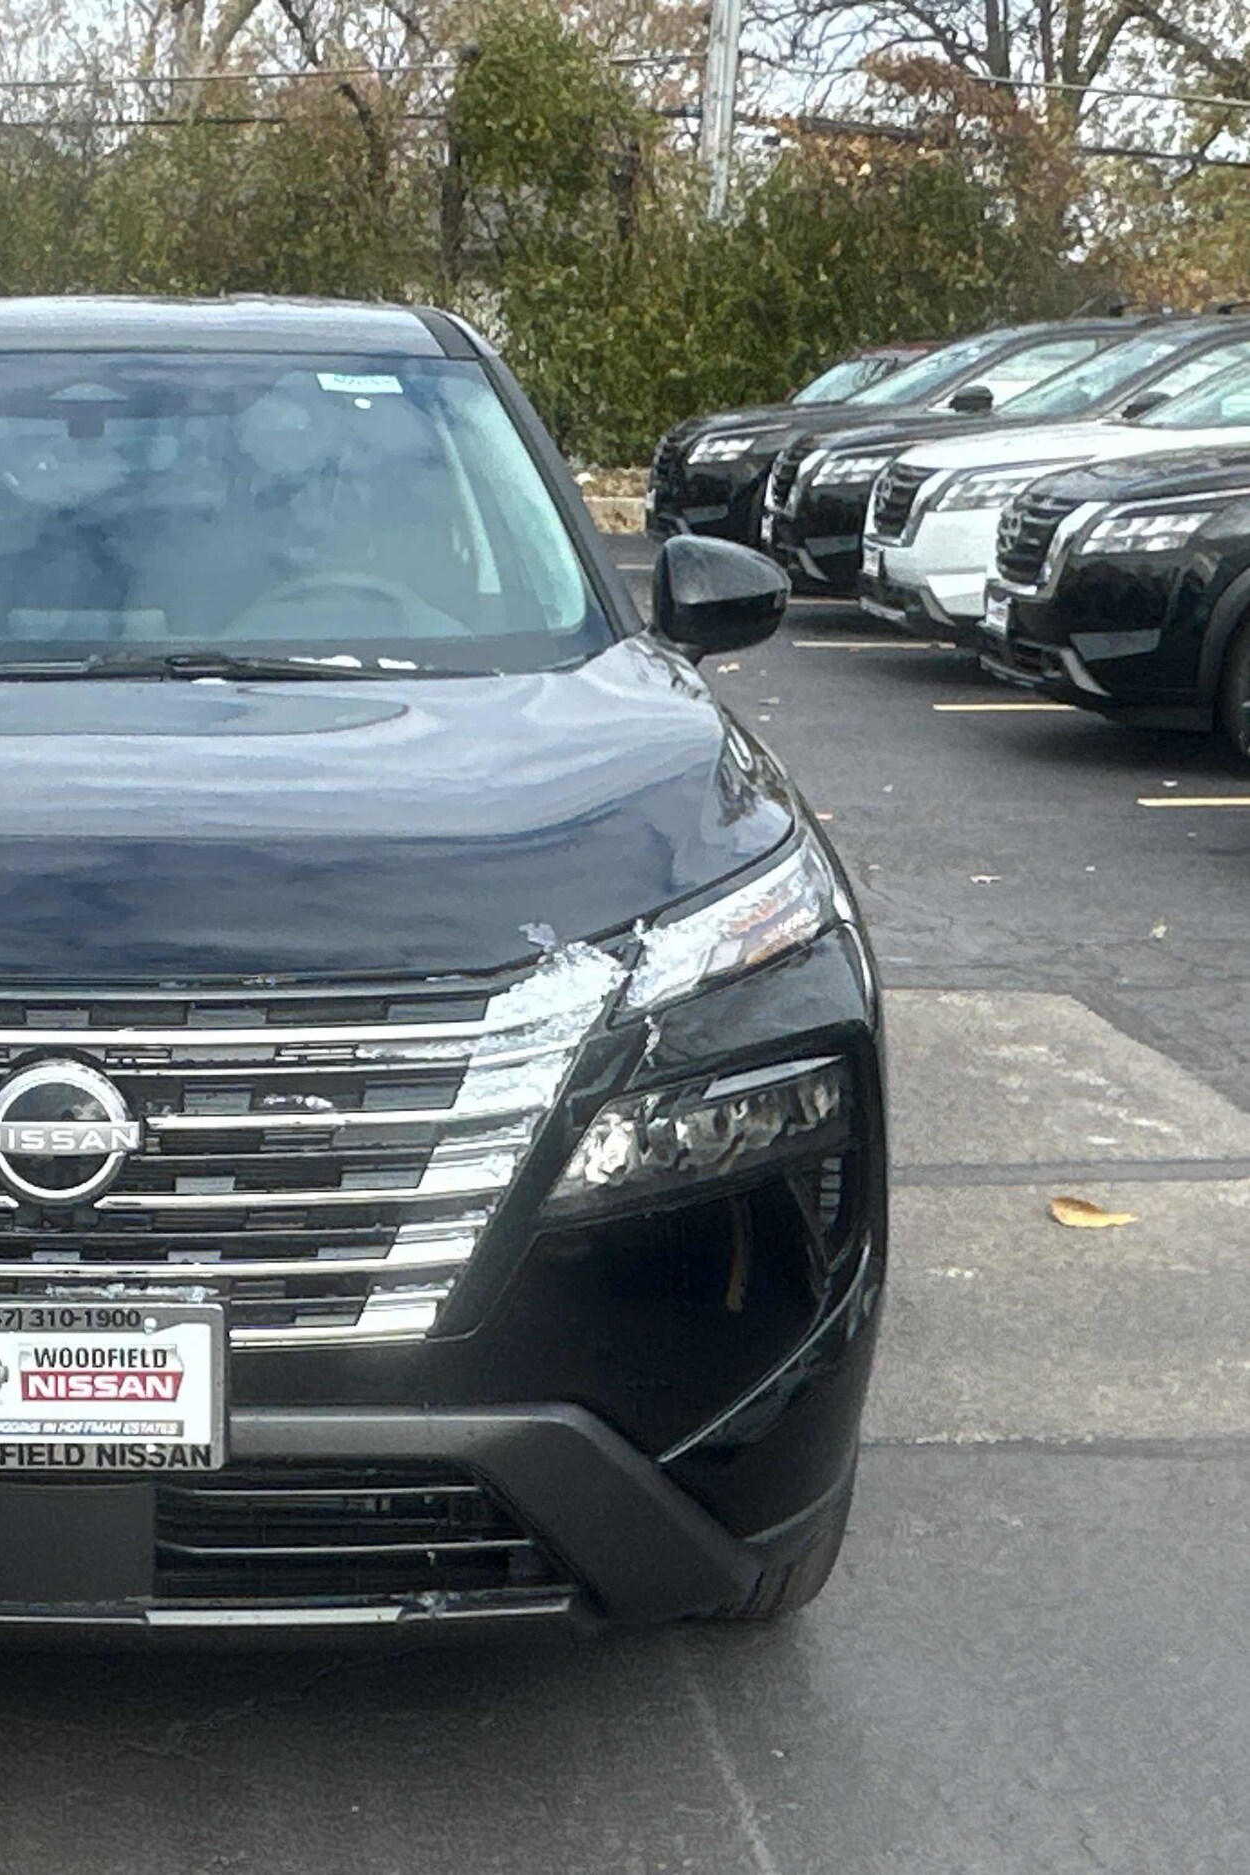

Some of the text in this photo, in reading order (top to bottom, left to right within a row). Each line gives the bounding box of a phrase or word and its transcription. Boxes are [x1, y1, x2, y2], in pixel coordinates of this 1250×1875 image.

[29, 1307, 141, 1328] 310-1900
[34, 1347, 168, 1368] WOODFIELD
[28, 1374, 173, 1398] NISSAN
[96, 1443, 212, 1467] NISSAN
